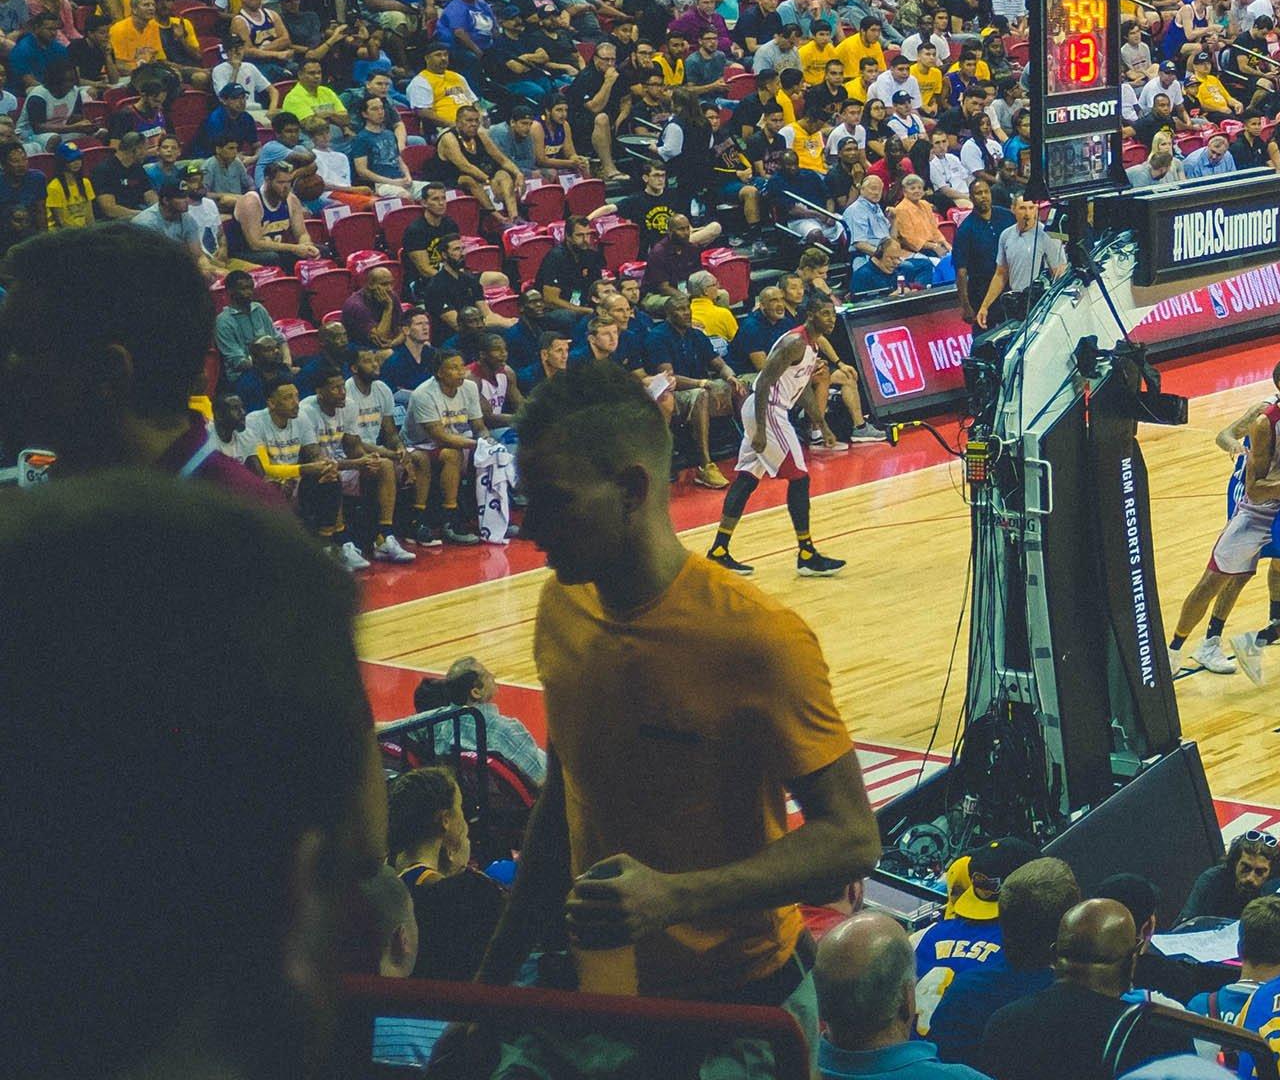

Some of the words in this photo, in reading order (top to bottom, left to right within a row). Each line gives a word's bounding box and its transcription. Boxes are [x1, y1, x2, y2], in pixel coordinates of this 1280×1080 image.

[1070, 37, 1096, 83] 13
[1069, 100, 1118, 120] TISSOT
[1173, 207, 1279, 262] #NBASummer
[887, 340, 915, 381] TV
[928, 333, 974, 371] MGM
[1121, 457, 1134, 493] MGM
[1124, 498, 1141, 565] RESORTS
[935, 940, 1001, 963] WEST
